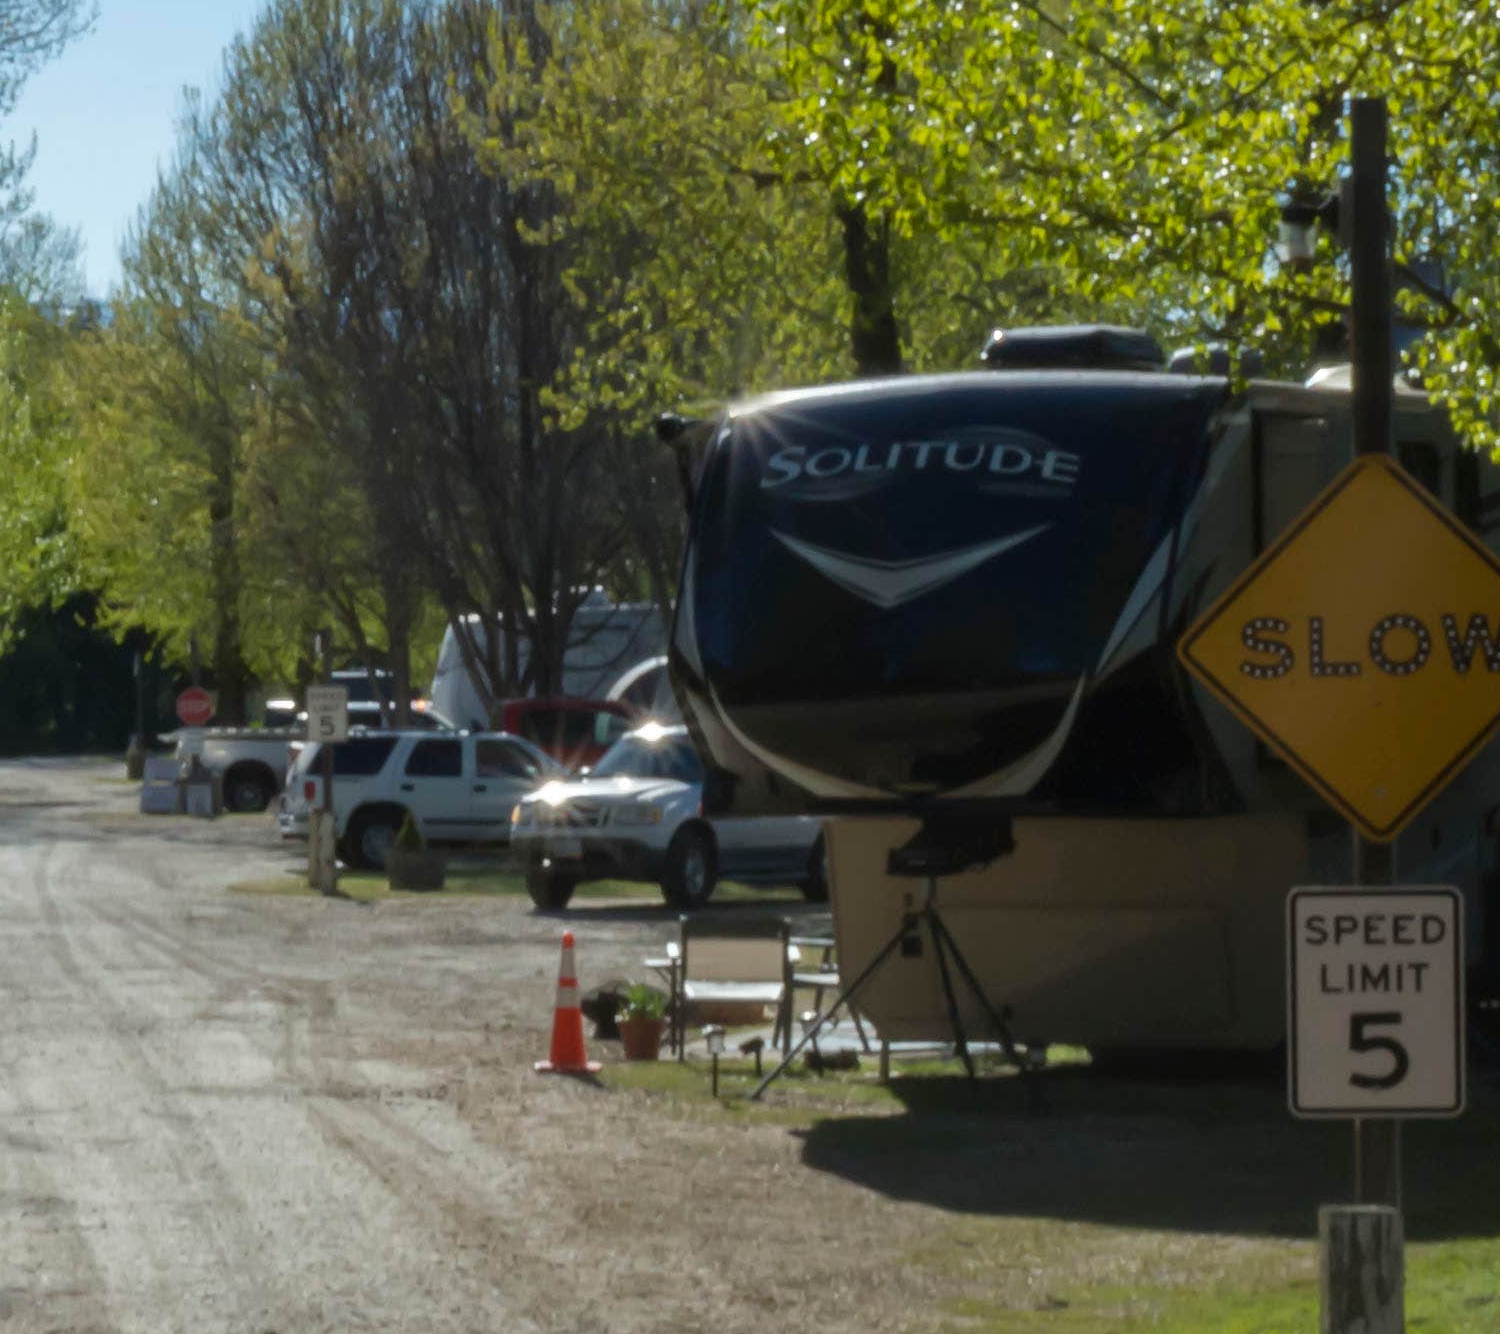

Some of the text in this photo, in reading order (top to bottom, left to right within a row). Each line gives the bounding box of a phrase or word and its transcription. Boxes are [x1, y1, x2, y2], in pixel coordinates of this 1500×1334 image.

[760, 441, 1080, 487] SOLITUDE
[320, 714, 336, 736] 5
[1305, 912, 1447, 947] SPEED
[1320, 963, 1430, 995] LIMIT
[1348, 1010, 1410, 1089] 5
